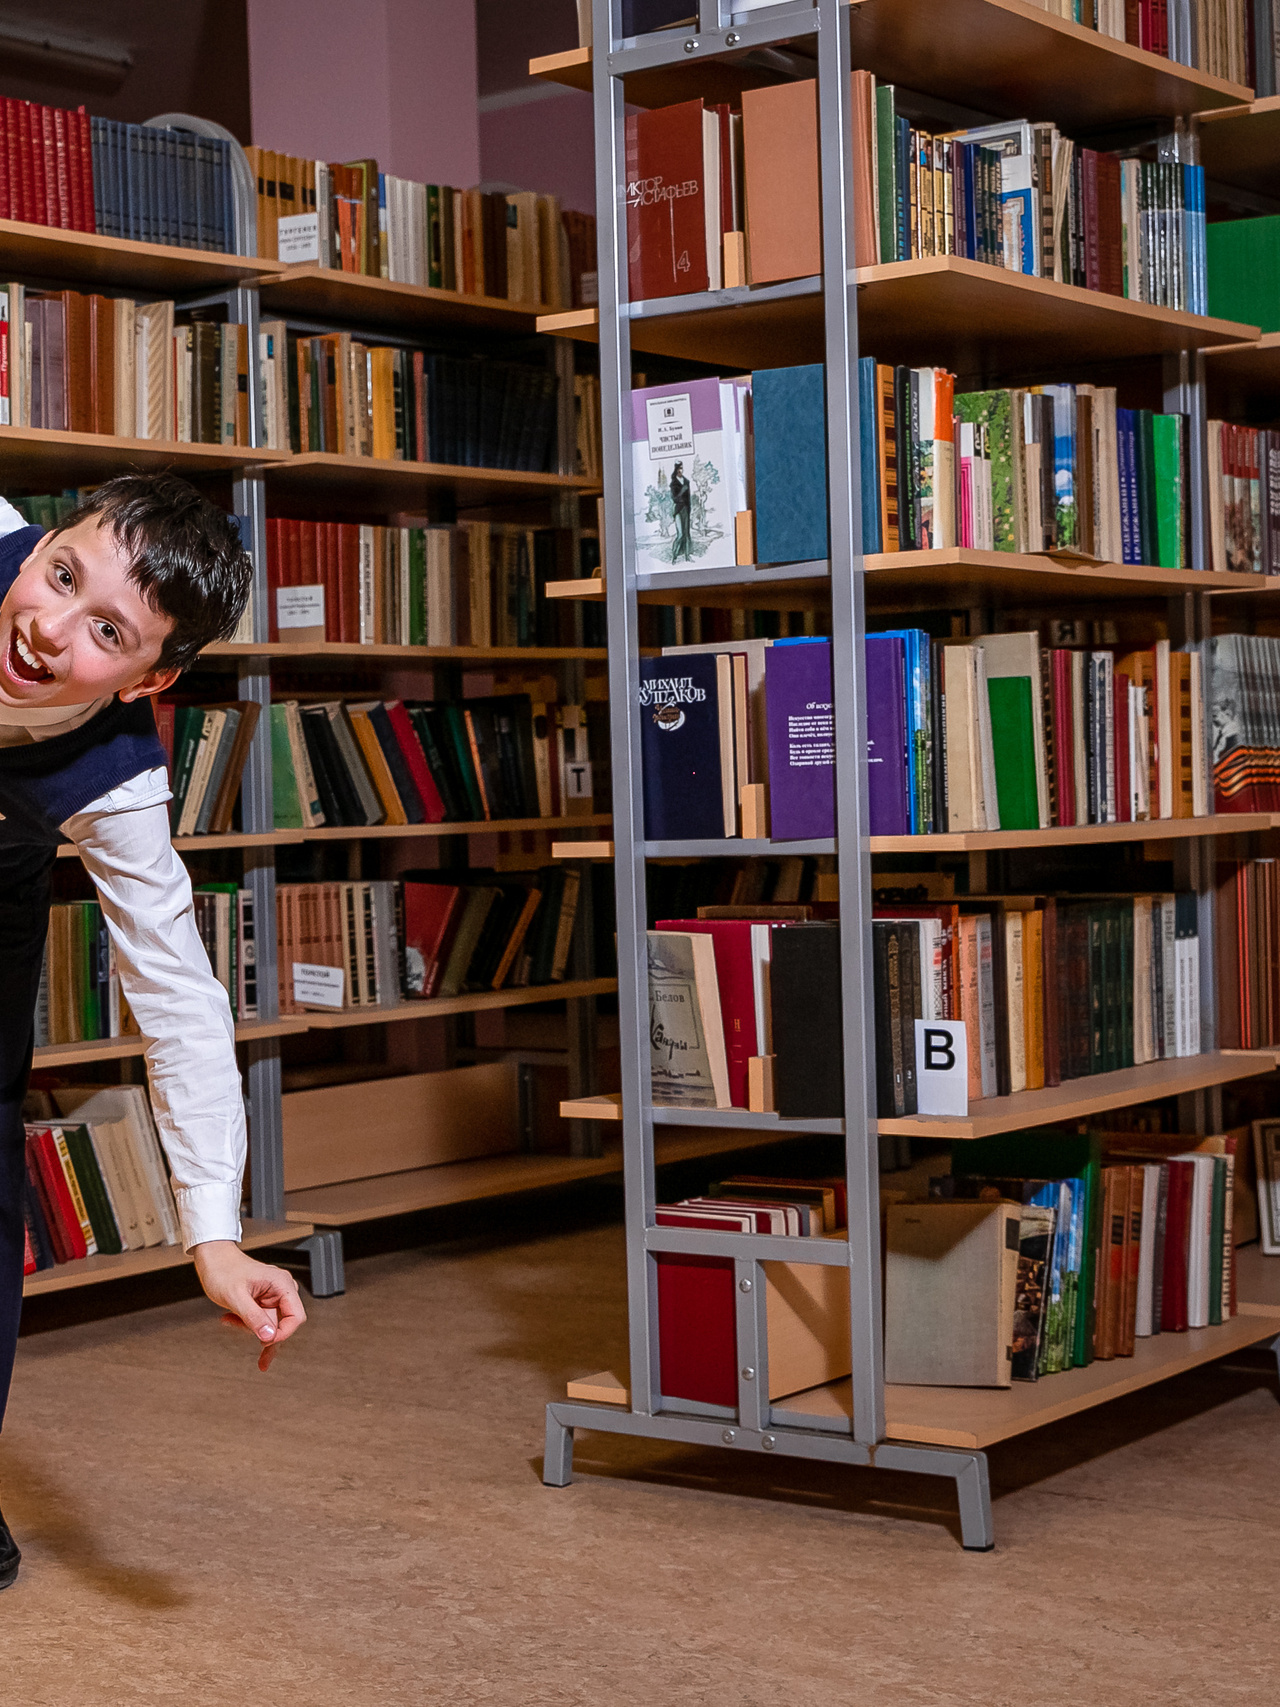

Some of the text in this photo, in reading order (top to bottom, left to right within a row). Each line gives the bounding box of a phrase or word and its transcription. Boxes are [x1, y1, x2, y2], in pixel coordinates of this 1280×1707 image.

[623, 175, 663, 195] ИКТОР
[634, 180, 699, 207] АСТАФЬЕВ
[676, 250, 691, 273] 4
[651, 442, 692, 453] ПОНЕДЕЛЬНИК
[659, 434, 683, 443] ЧИСТЫЙ
[571, 768, 585, 793] Т
[655, 990, 685, 1003] Белов
[924, 1028, 955, 1071] В
